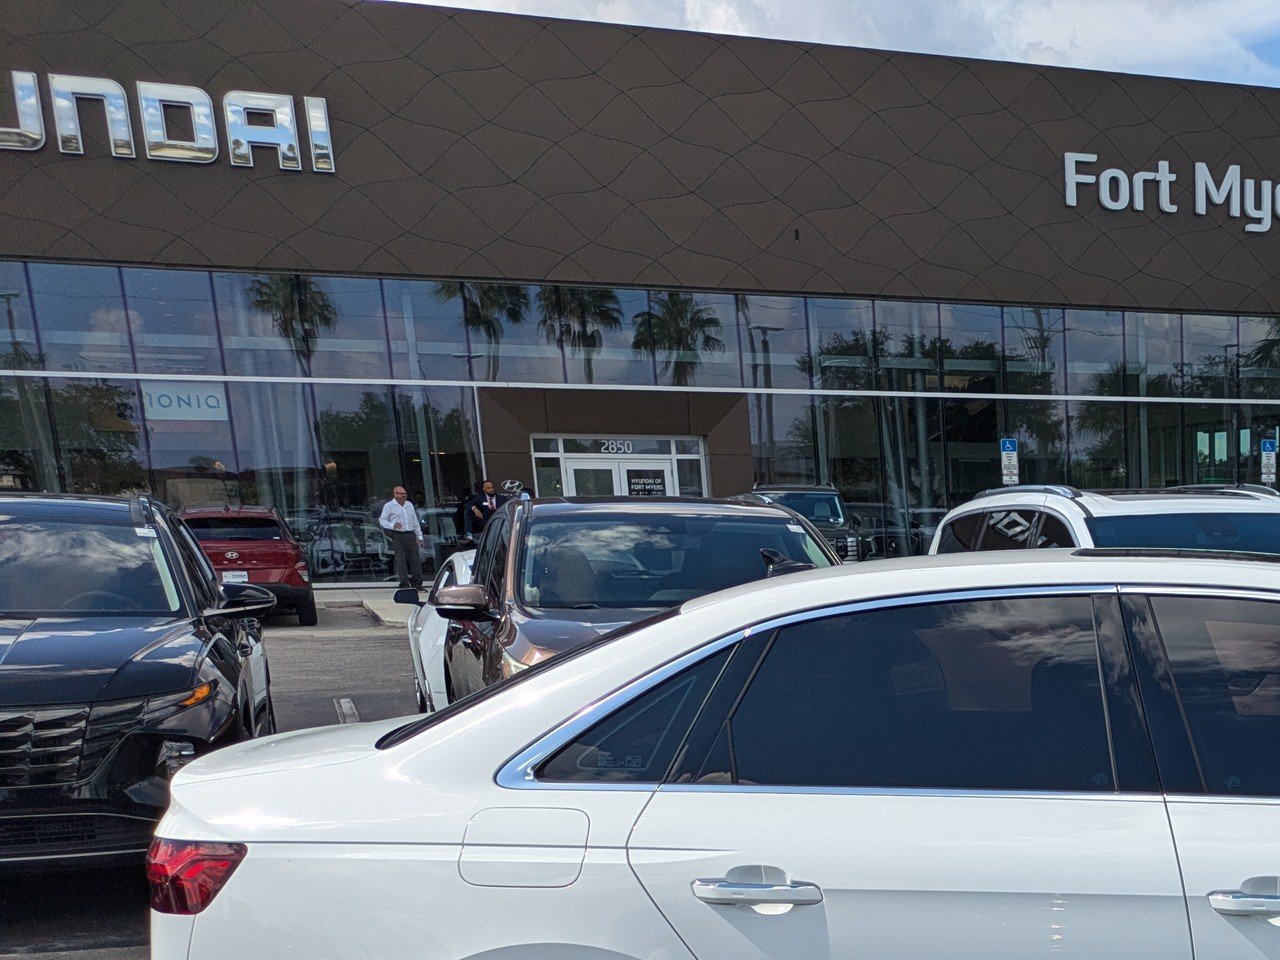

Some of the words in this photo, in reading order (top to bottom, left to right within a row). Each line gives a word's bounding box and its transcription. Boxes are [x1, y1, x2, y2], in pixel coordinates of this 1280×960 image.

[1064, 151, 1178, 213] Fort
[147, 392, 221, 410] IONIQ
[601, 440, 633, 454] 2850
